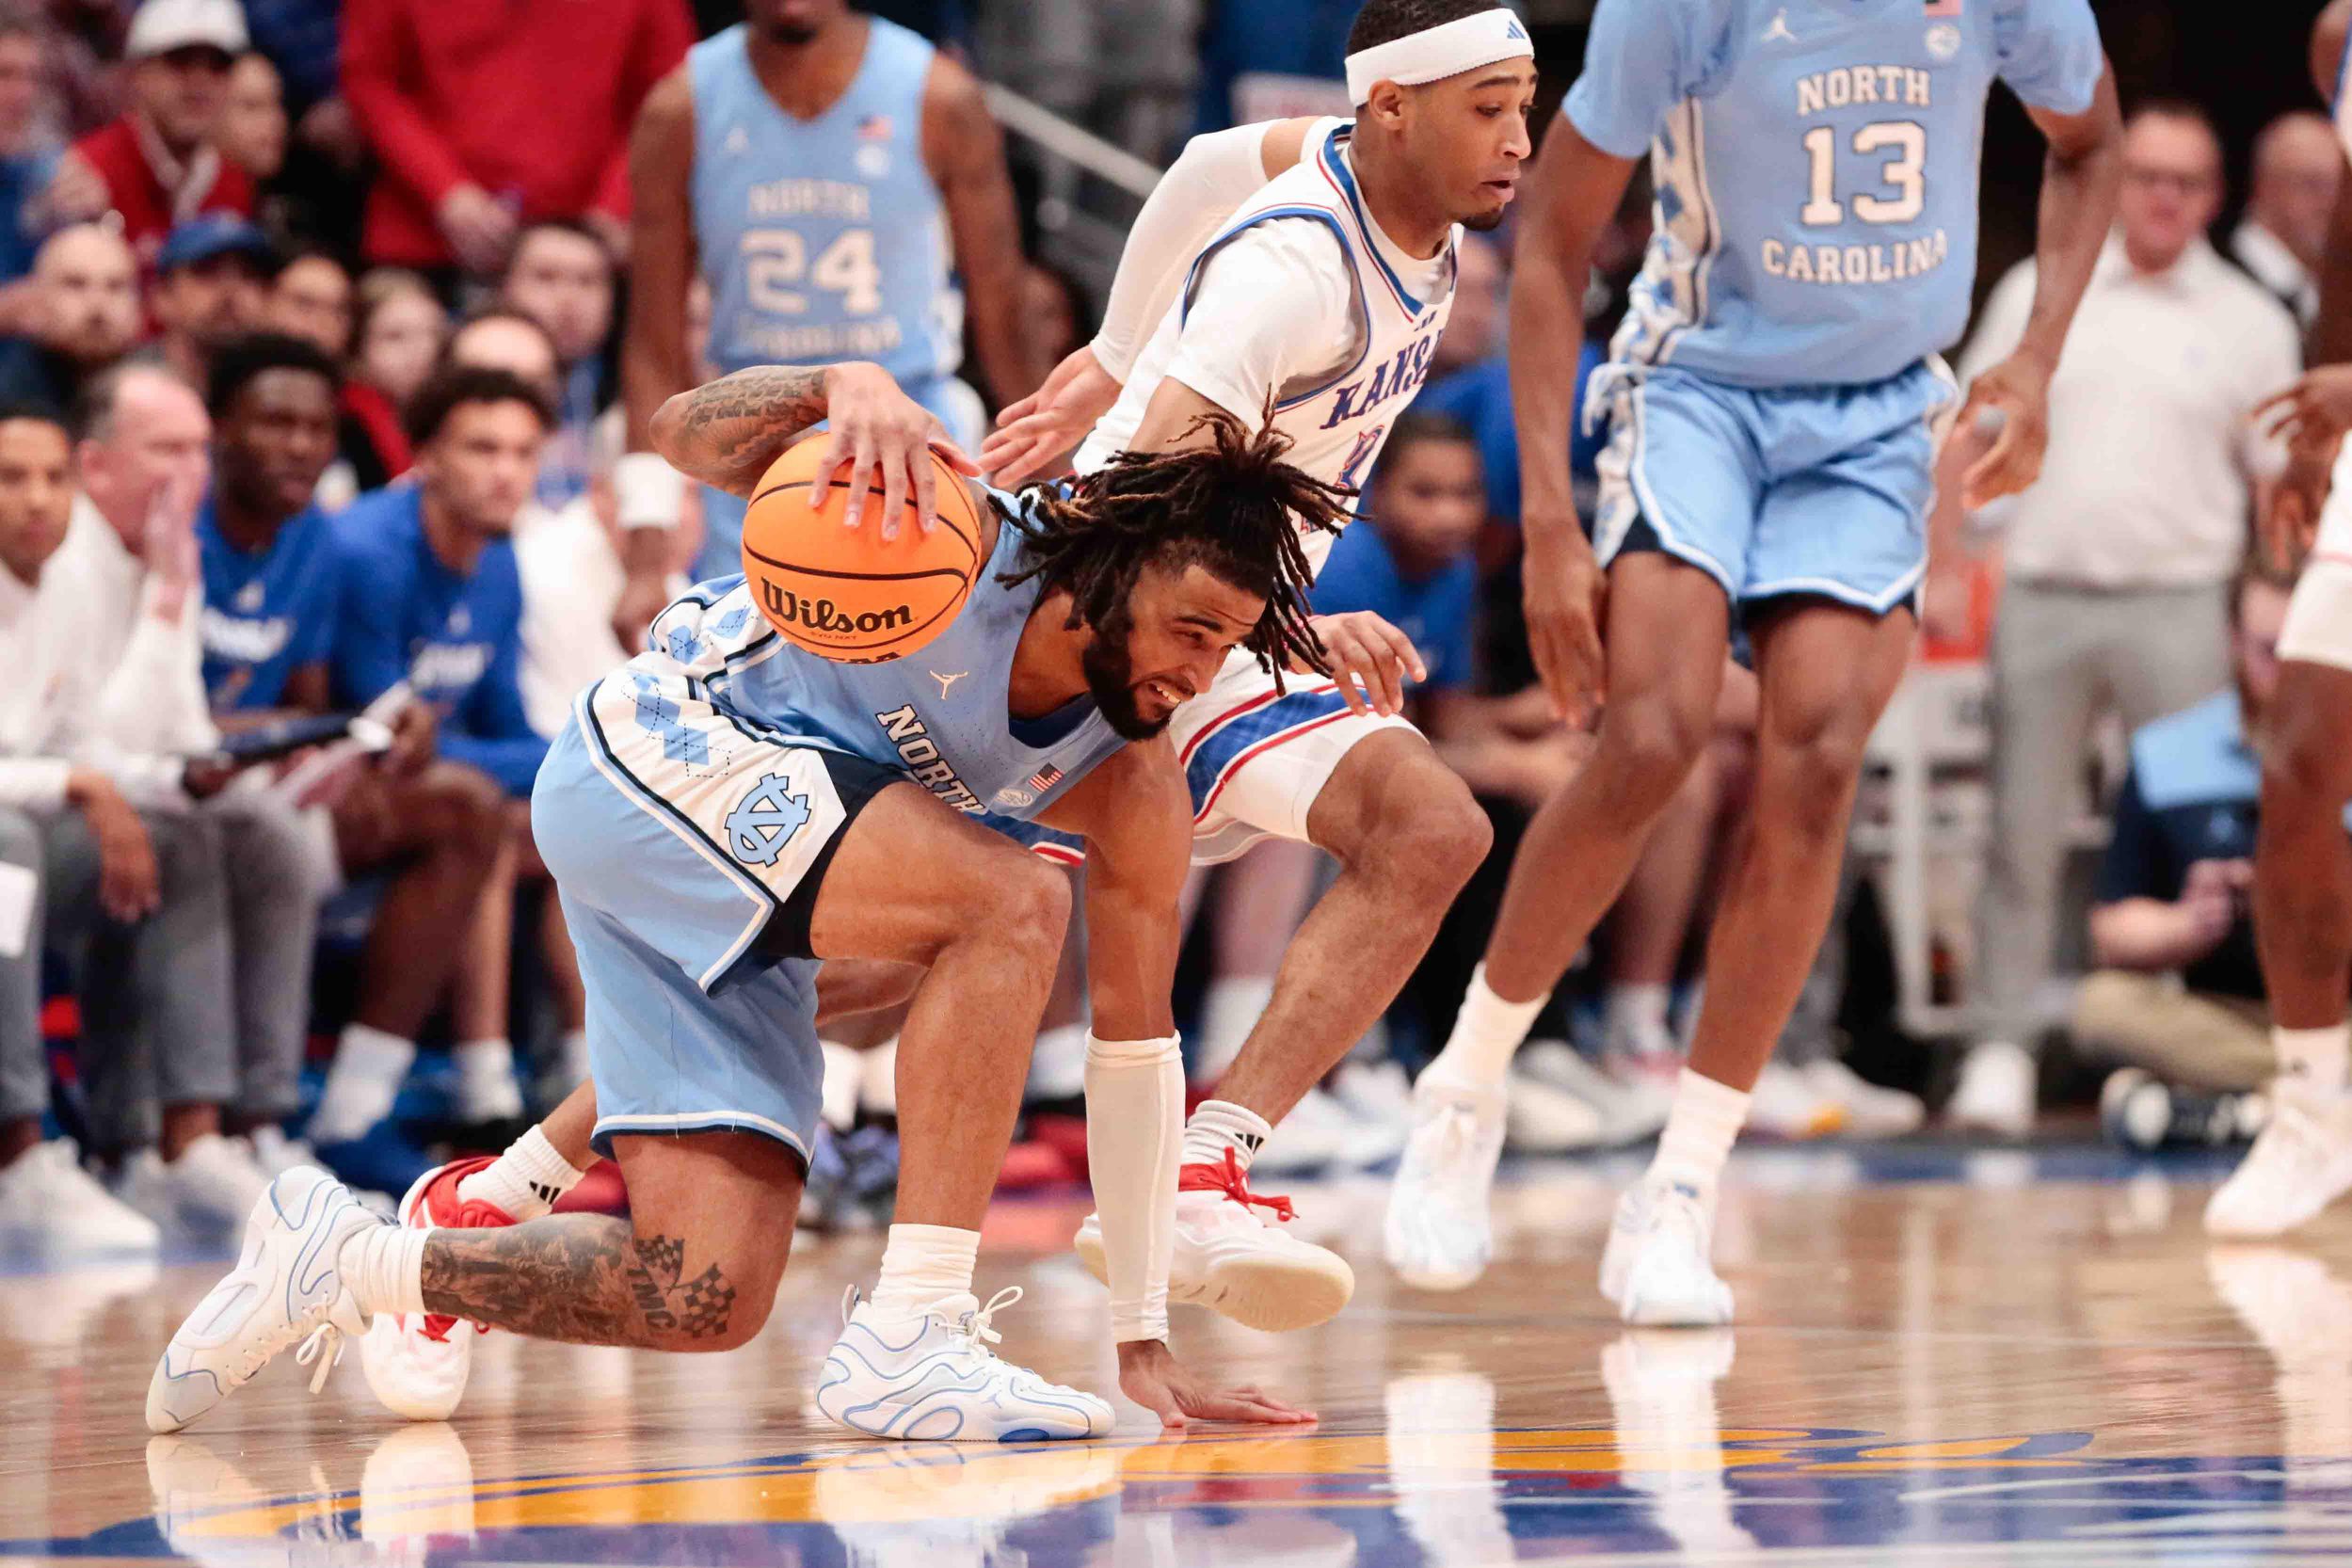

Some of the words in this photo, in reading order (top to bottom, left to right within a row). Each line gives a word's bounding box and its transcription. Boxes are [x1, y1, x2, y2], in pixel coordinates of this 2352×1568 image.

[1797, 65, 1930, 117] NORTH
[1800, 120, 1927, 226] 13
[740, 229, 882, 314] 24
[1761, 228, 1948, 284] CAROLINA
[760, 576, 913, 633] Wilson
[875, 704, 985, 813] NORTH
